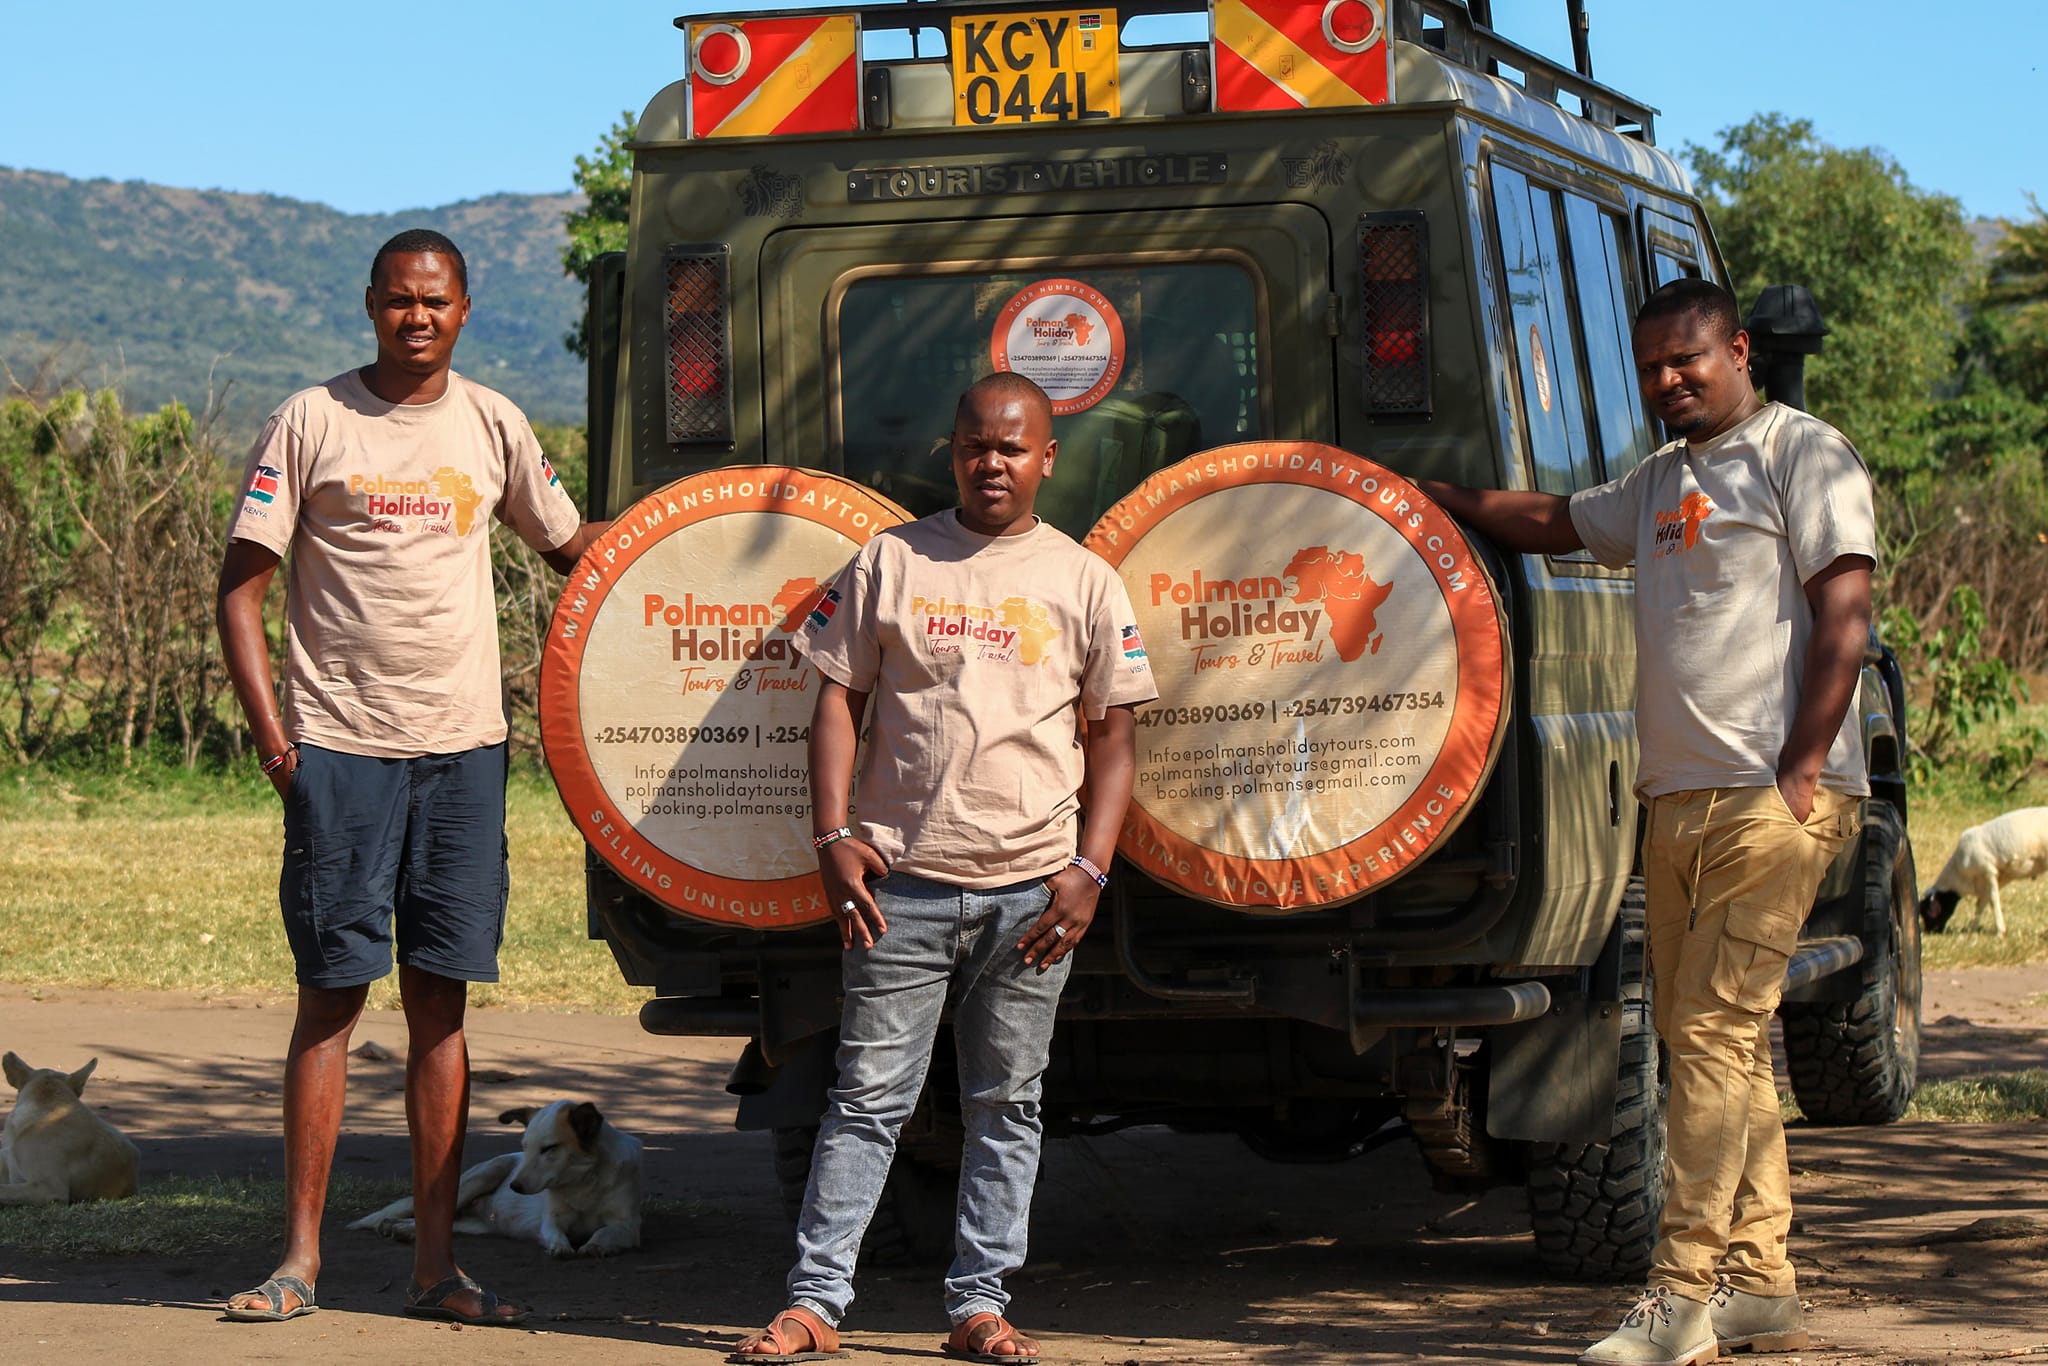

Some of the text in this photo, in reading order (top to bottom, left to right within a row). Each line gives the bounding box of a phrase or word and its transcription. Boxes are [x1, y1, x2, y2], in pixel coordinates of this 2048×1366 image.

[964, 17, 1070, 73] KCY
[967, 72, 1110, 125] 044L
[865, 156, 1210, 199] TOURIST VEHICLE
[1009, 284, 1108, 313] YOUR NUMBER ONE
[1034, 328, 1074, 340] Holiday
[1053, 355, 1119, 412] TRANSPORT PARTNER
[243, 505, 268, 518] KENYA
[368, 495, 452, 520] Holiday
[1106, 453, 1468, 593] .POLMANSHOLIDAYTOURS.COM
[419, 518, 452, 534] Travel
[562, 481, 886, 640] WWW.POLMANSHOLIDAYTOU
[1150, 569, 1301, 607] Polmans
[644, 593, 788, 627] Polmans
[1181, 600, 1322, 642] Holiday
[804, 619, 819, 635] ENYA
[927, 616, 1017, 649] Holiday
[672, 628, 802, 670] Holiday
[931, 638, 961, 656] Tours
[977, 644, 1014, 662] Travel
[1191, 639, 1324, 675] Tours & Travel
[680, 667, 808, 696] Tours & Travel
[1130, 664, 1147, 674] VISIT
[1134, 702, 1266, 729] 4703890369
[1283, 690, 1445, 719] +254739467354
[594, 727, 750, 745] +254703890369
[1148, 734, 1416, 765] Info@polmansholidaytours.com
[1140, 753, 1421, 786] polmansholidaytours@gmail.com
[1156, 771, 1406, 800] booking.polmans@gmail.com
[1125, 783, 1456, 898] LLING UNIQUE EXPERIENCE
[590, 809, 780, 916] SELLING UNIQUE
